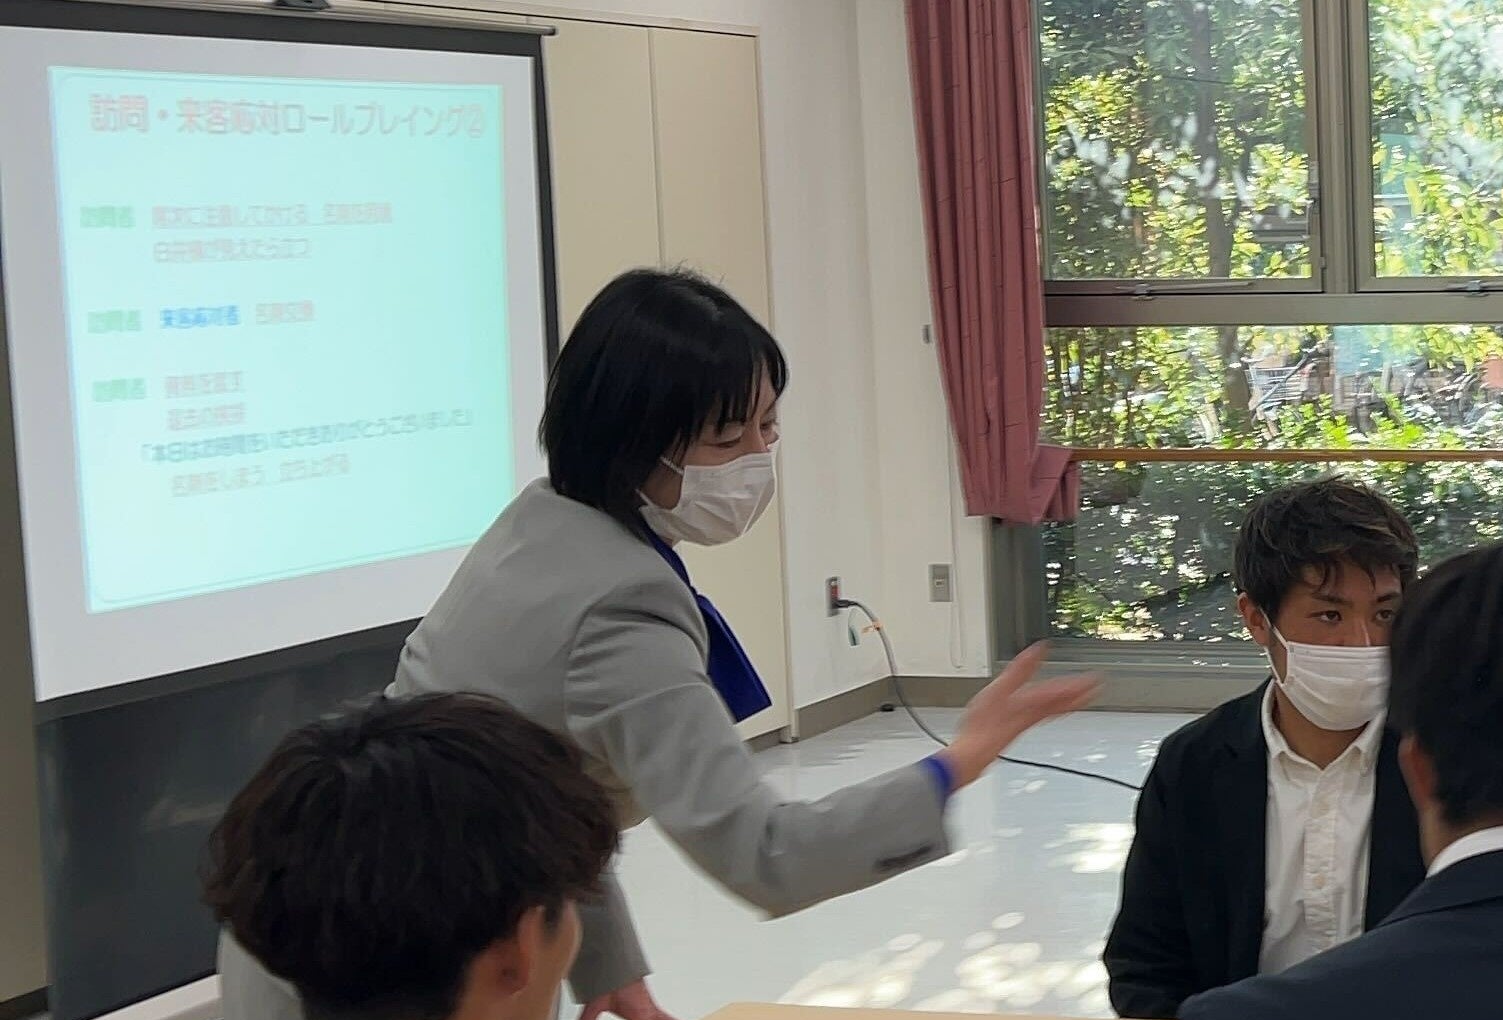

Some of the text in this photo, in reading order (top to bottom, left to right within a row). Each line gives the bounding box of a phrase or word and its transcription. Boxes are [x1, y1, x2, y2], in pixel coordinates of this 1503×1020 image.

[89, 93, 484, 137] 訪問・来客応対ロールプレイング②
